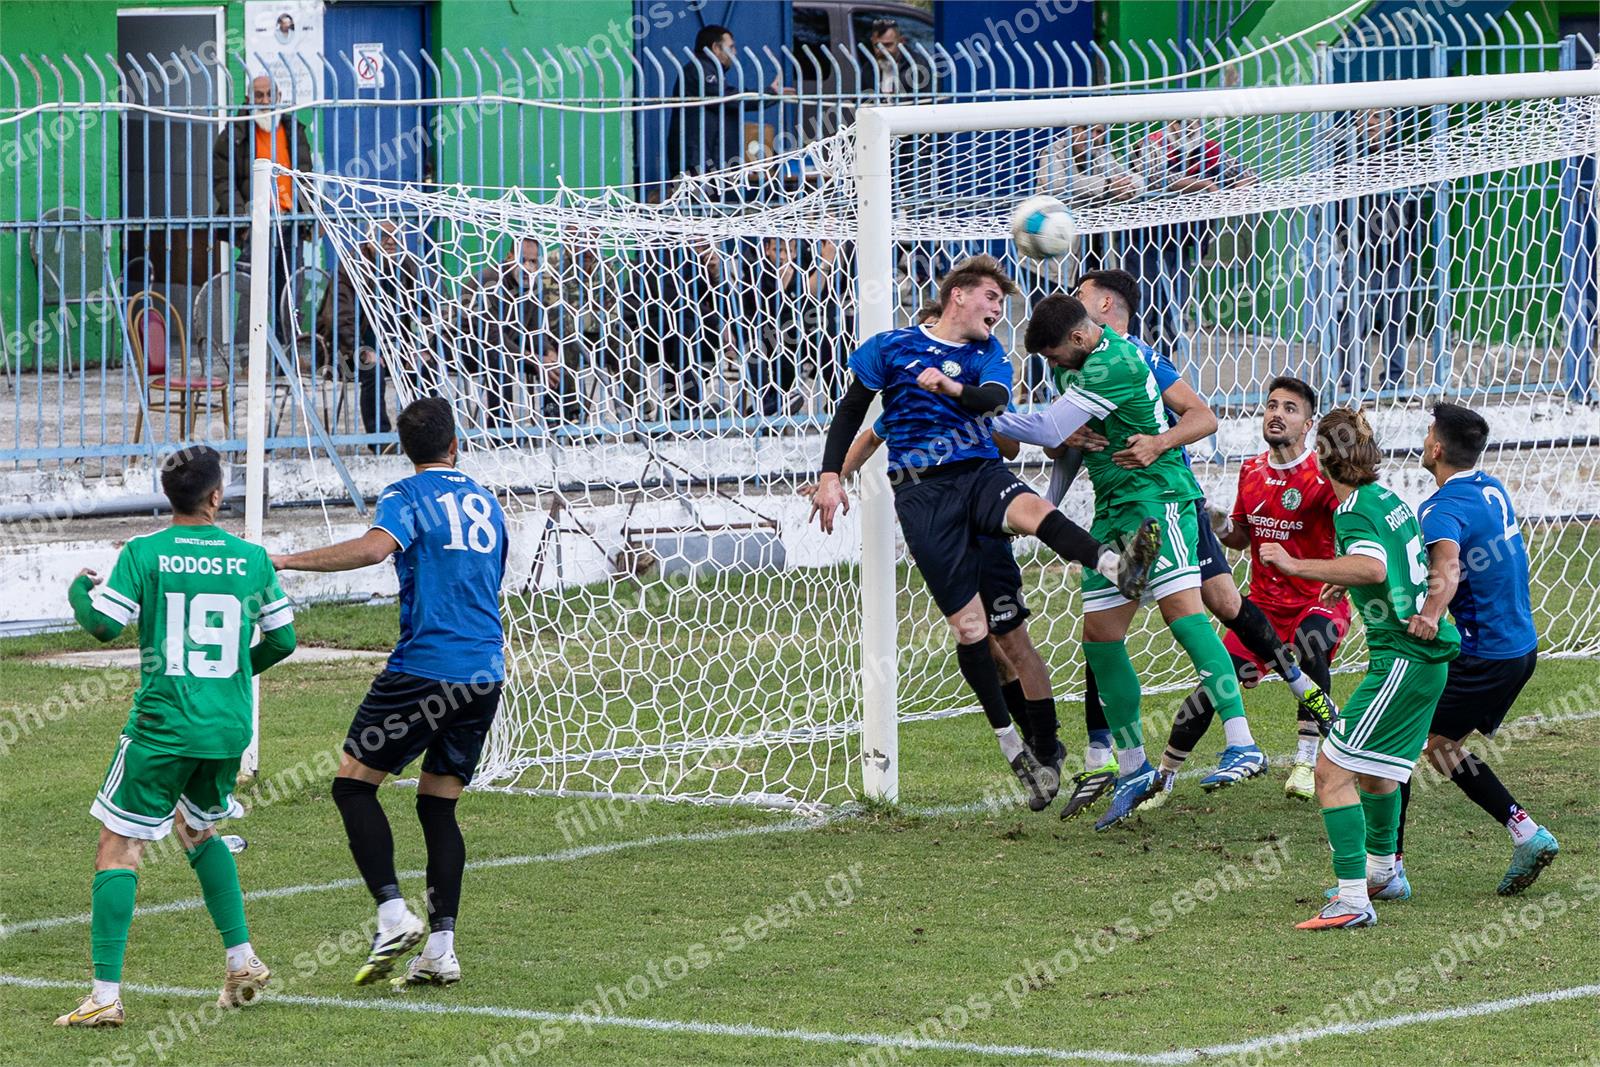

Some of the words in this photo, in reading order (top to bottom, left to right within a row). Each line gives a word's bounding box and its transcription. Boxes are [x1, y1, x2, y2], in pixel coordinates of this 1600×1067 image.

[436, 492, 497, 554] 18
[1280, 520, 1304, 530] GAS
[1482, 486, 1520, 541] 2
[1255, 527, 1290, 540] SYSTEM
[158, 554, 224, 575] RODOS
[226, 557, 248, 576] FC
[164, 592, 242, 679] 19
